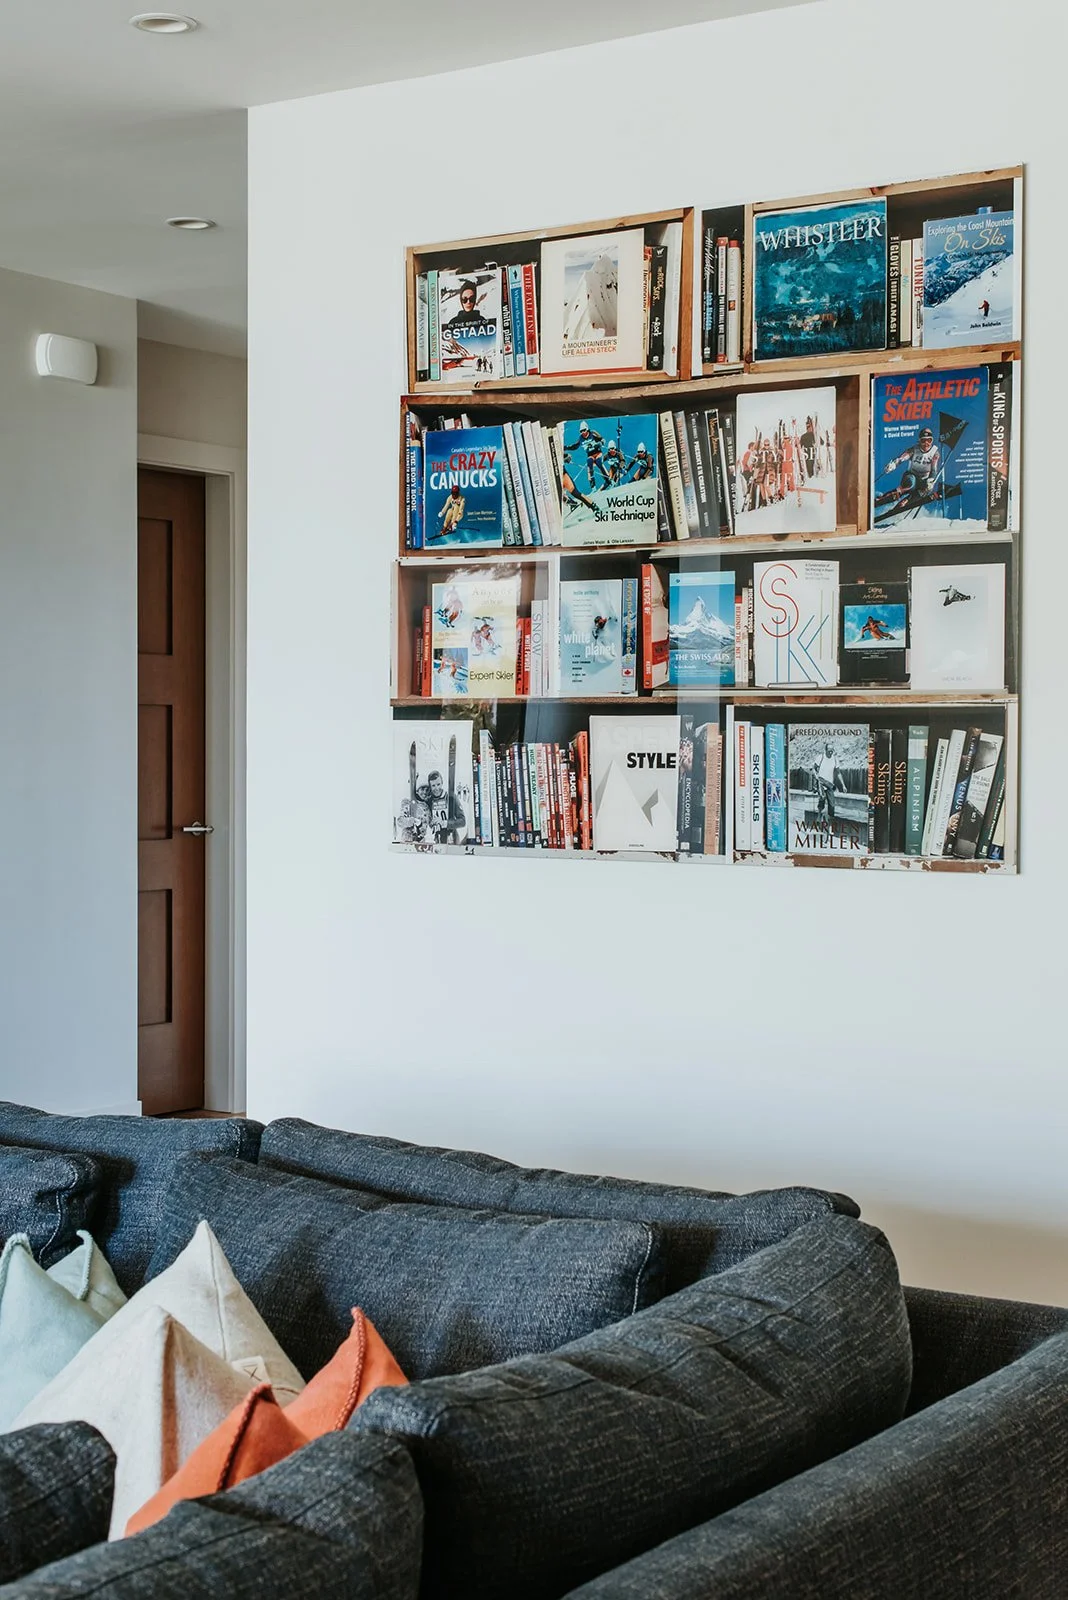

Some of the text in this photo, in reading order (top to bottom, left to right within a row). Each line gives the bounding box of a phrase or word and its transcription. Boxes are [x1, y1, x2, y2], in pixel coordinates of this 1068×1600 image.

[759, 217, 882, 251] WHISTLER
[928, 225, 956, 236] Exploring
[957, 223, 967, 231] the
[968, 220, 985, 231] Coast
[944, 228, 1006, 252] On Skis
[889, 244, 900, 277] GLOVES
[525, 272, 533, 290] THE
[914, 257, 924, 299] TUNNEY
[526, 291, 535, 315] FALL
[502, 304, 511, 327] white
[527, 315, 536, 336] LINE
[890, 302, 898, 334] ANASI
[443, 324, 496, 341] GSTAAD
[568, 339, 617, 349] MOUNTAINEER'S
[576, 347, 596, 355] ALLEN
[597, 345, 617, 353] STECK
[885, 378, 981, 402] THE ATHLETIC
[883, 398, 933, 422] SKIER
[993, 392, 1006, 419] KING
[663, 429, 680, 481] UNBEATABLE
[752, 447, 818, 464] STYLSH
[992, 426, 1005, 468] SPORTS
[431, 451, 496, 473] THE CRAZY
[410, 468, 418, 488] BODY
[430, 469, 497, 491] CANUCKS
[989, 472, 999, 508] Easterbrook
[995, 480, 1004, 499] Gregg
[509, 498, 519, 529] STRONG
[606, 495, 655, 508] World Cup
[595, 509, 655, 523] Ski Technique
[643, 576, 651, 616] THE EDGE OF
[531, 613, 543, 657] SNOW
[564, 632, 591, 645] white
[585, 643, 620, 659] planet
[690, 653, 711, 661] SWISS
[470, 670, 514, 682] Expert Skier
[795, 728, 863, 737] FREEDOM FOUND
[627, 753, 677, 769] STYLE
[768, 728, 779, 778] Hard Courts
[530, 771, 538, 796] FREAKY
[569, 772, 577, 798] HUGE
[874, 763, 890, 805] Skiing
[890, 761, 907, 804] Skiing
[684, 777, 692, 829] ENCYCLOPEDIA
[752, 778, 760, 822] SKILLS
[911, 767, 920, 832] ALPINISM
[955, 780, 968, 811] VENUS
[795, 820, 861, 833] WARREN
[950, 814, 962, 838] ENVY
[795, 834, 861, 850] MILLER
